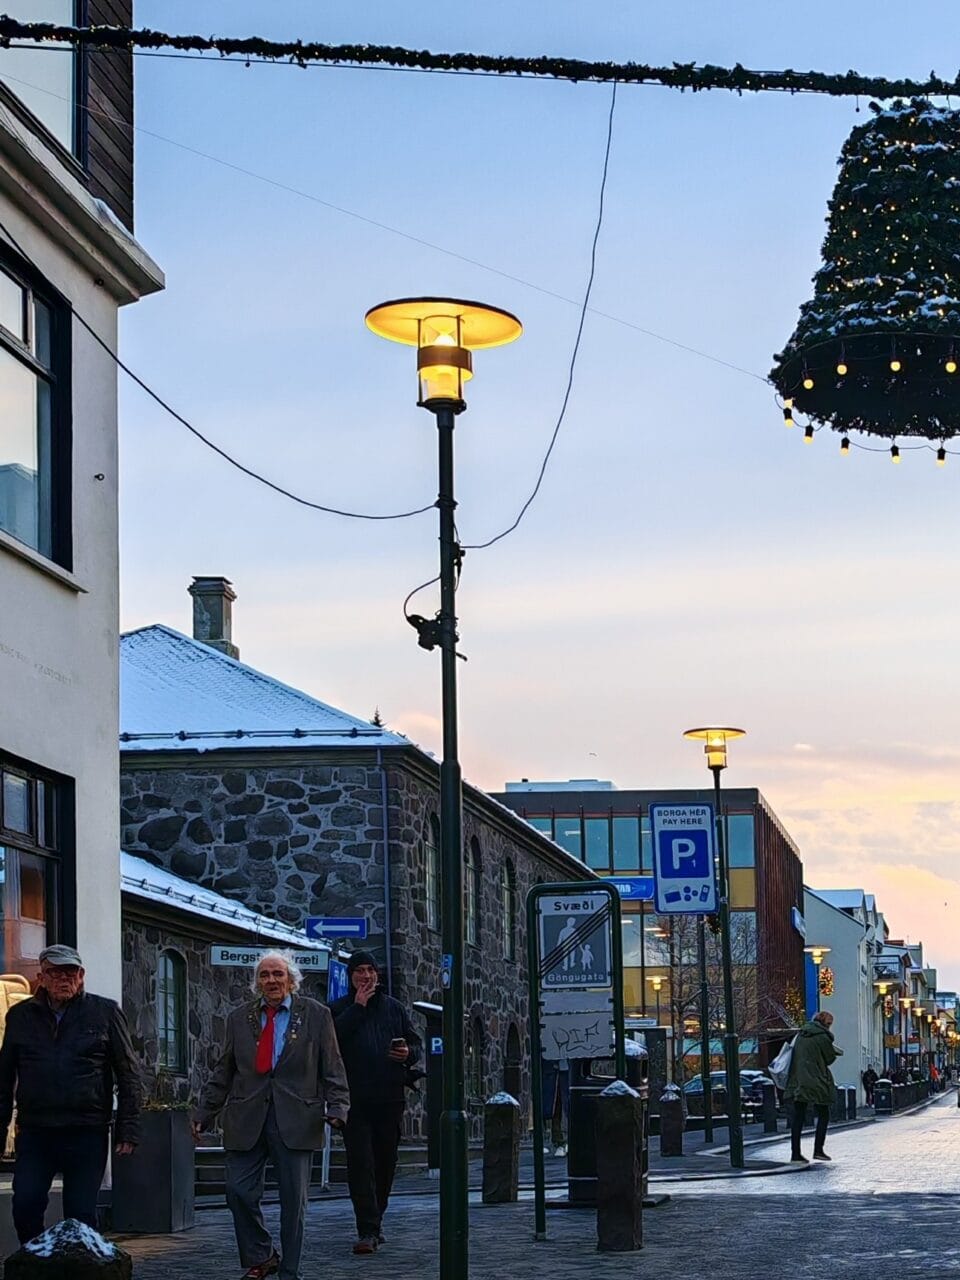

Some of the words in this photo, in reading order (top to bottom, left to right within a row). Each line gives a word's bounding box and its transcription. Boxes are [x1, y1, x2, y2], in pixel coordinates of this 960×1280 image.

[680, 817, 703, 825] HERE
[672, 838, 696, 870] P
[553, 900, 595, 912] Svæði
[547, 973, 604, 983] Göngugata
[431, 1037, 443, 1051] P
